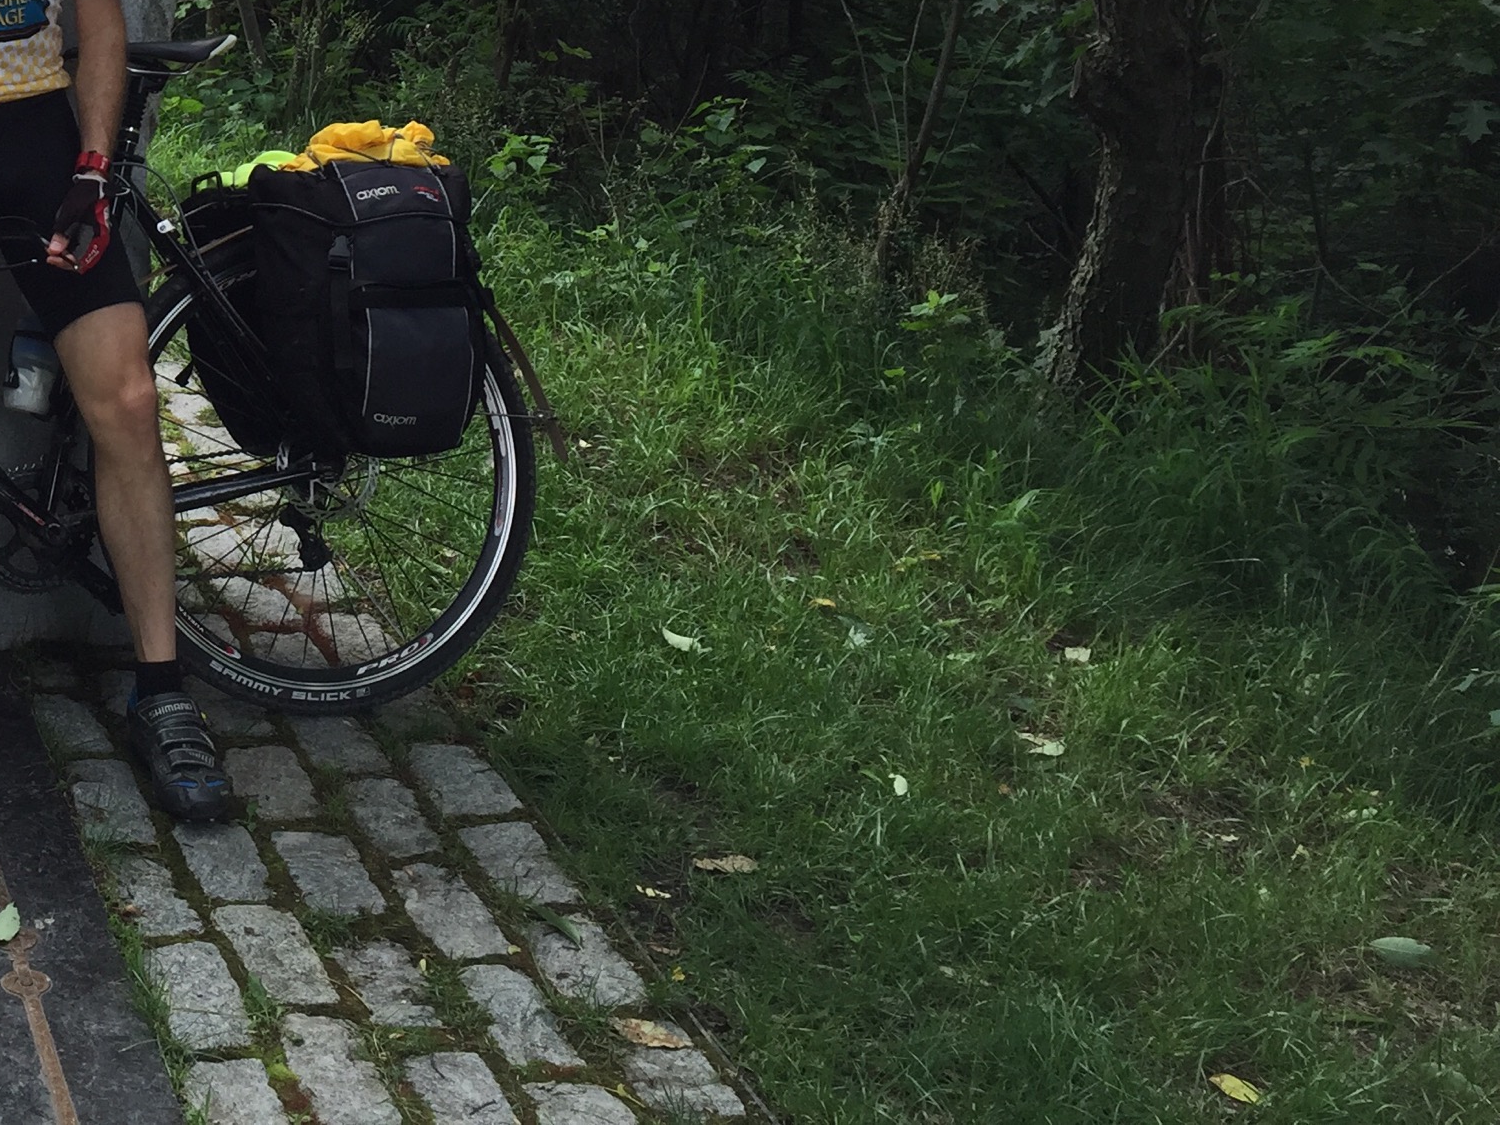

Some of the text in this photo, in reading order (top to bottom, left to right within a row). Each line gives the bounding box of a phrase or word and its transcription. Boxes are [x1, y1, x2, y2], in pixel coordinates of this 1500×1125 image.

[356, 185, 400, 200] axiom
[373, 413, 417, 430] axiom
[356, 639, 420, 676] PRO
[208, 659, 283, 696] SAMMY
[290, 690, 352, 702] SLICK
[148, 702, 194, 720] SHIMANO
